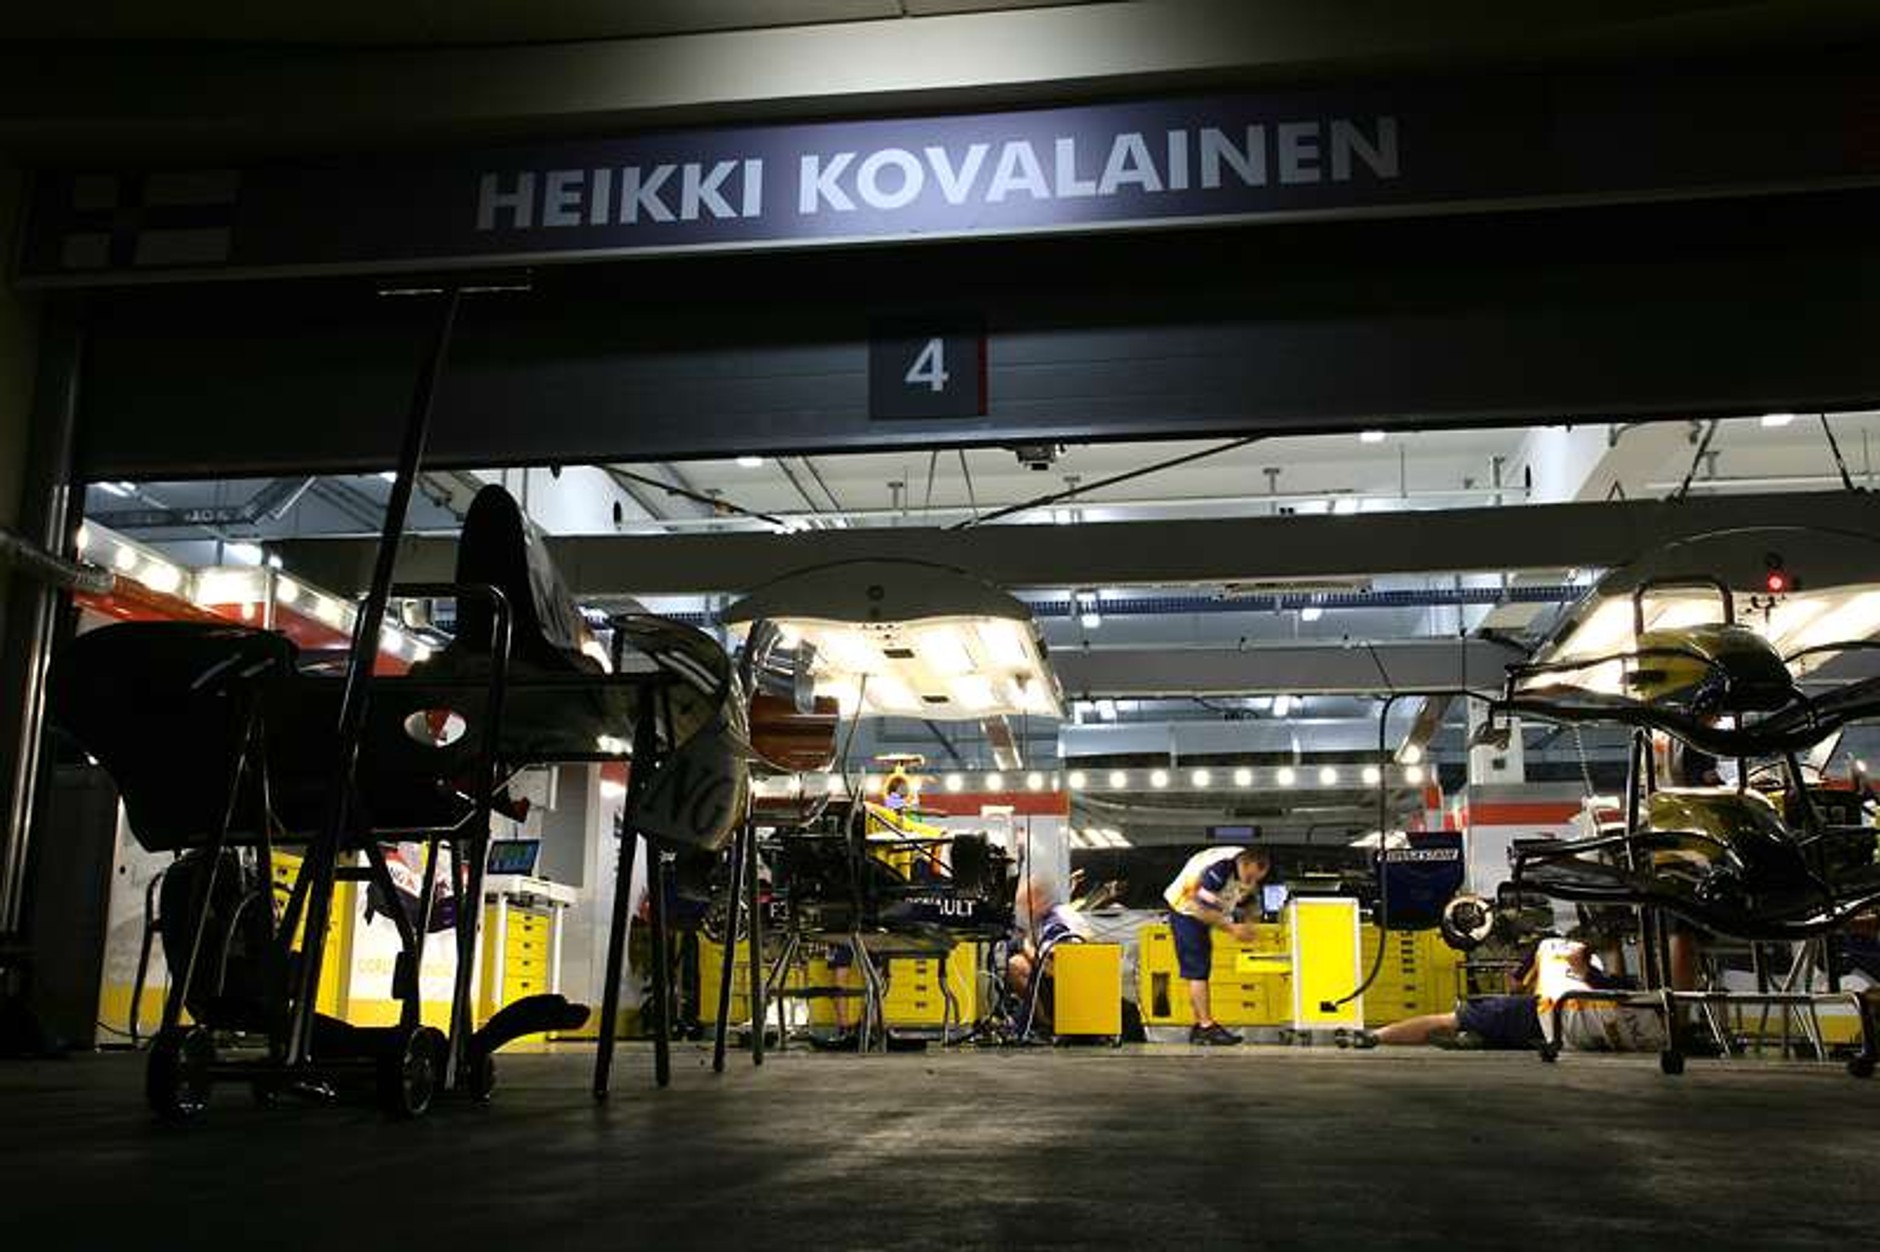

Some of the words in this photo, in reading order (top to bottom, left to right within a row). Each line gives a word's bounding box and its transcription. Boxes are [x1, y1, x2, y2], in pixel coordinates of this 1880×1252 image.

[476, 158, 764, 231] HEIKKI
[799, 115, 1402, 214] KOVALAINEN
[905, 338, 950, 392] 4
